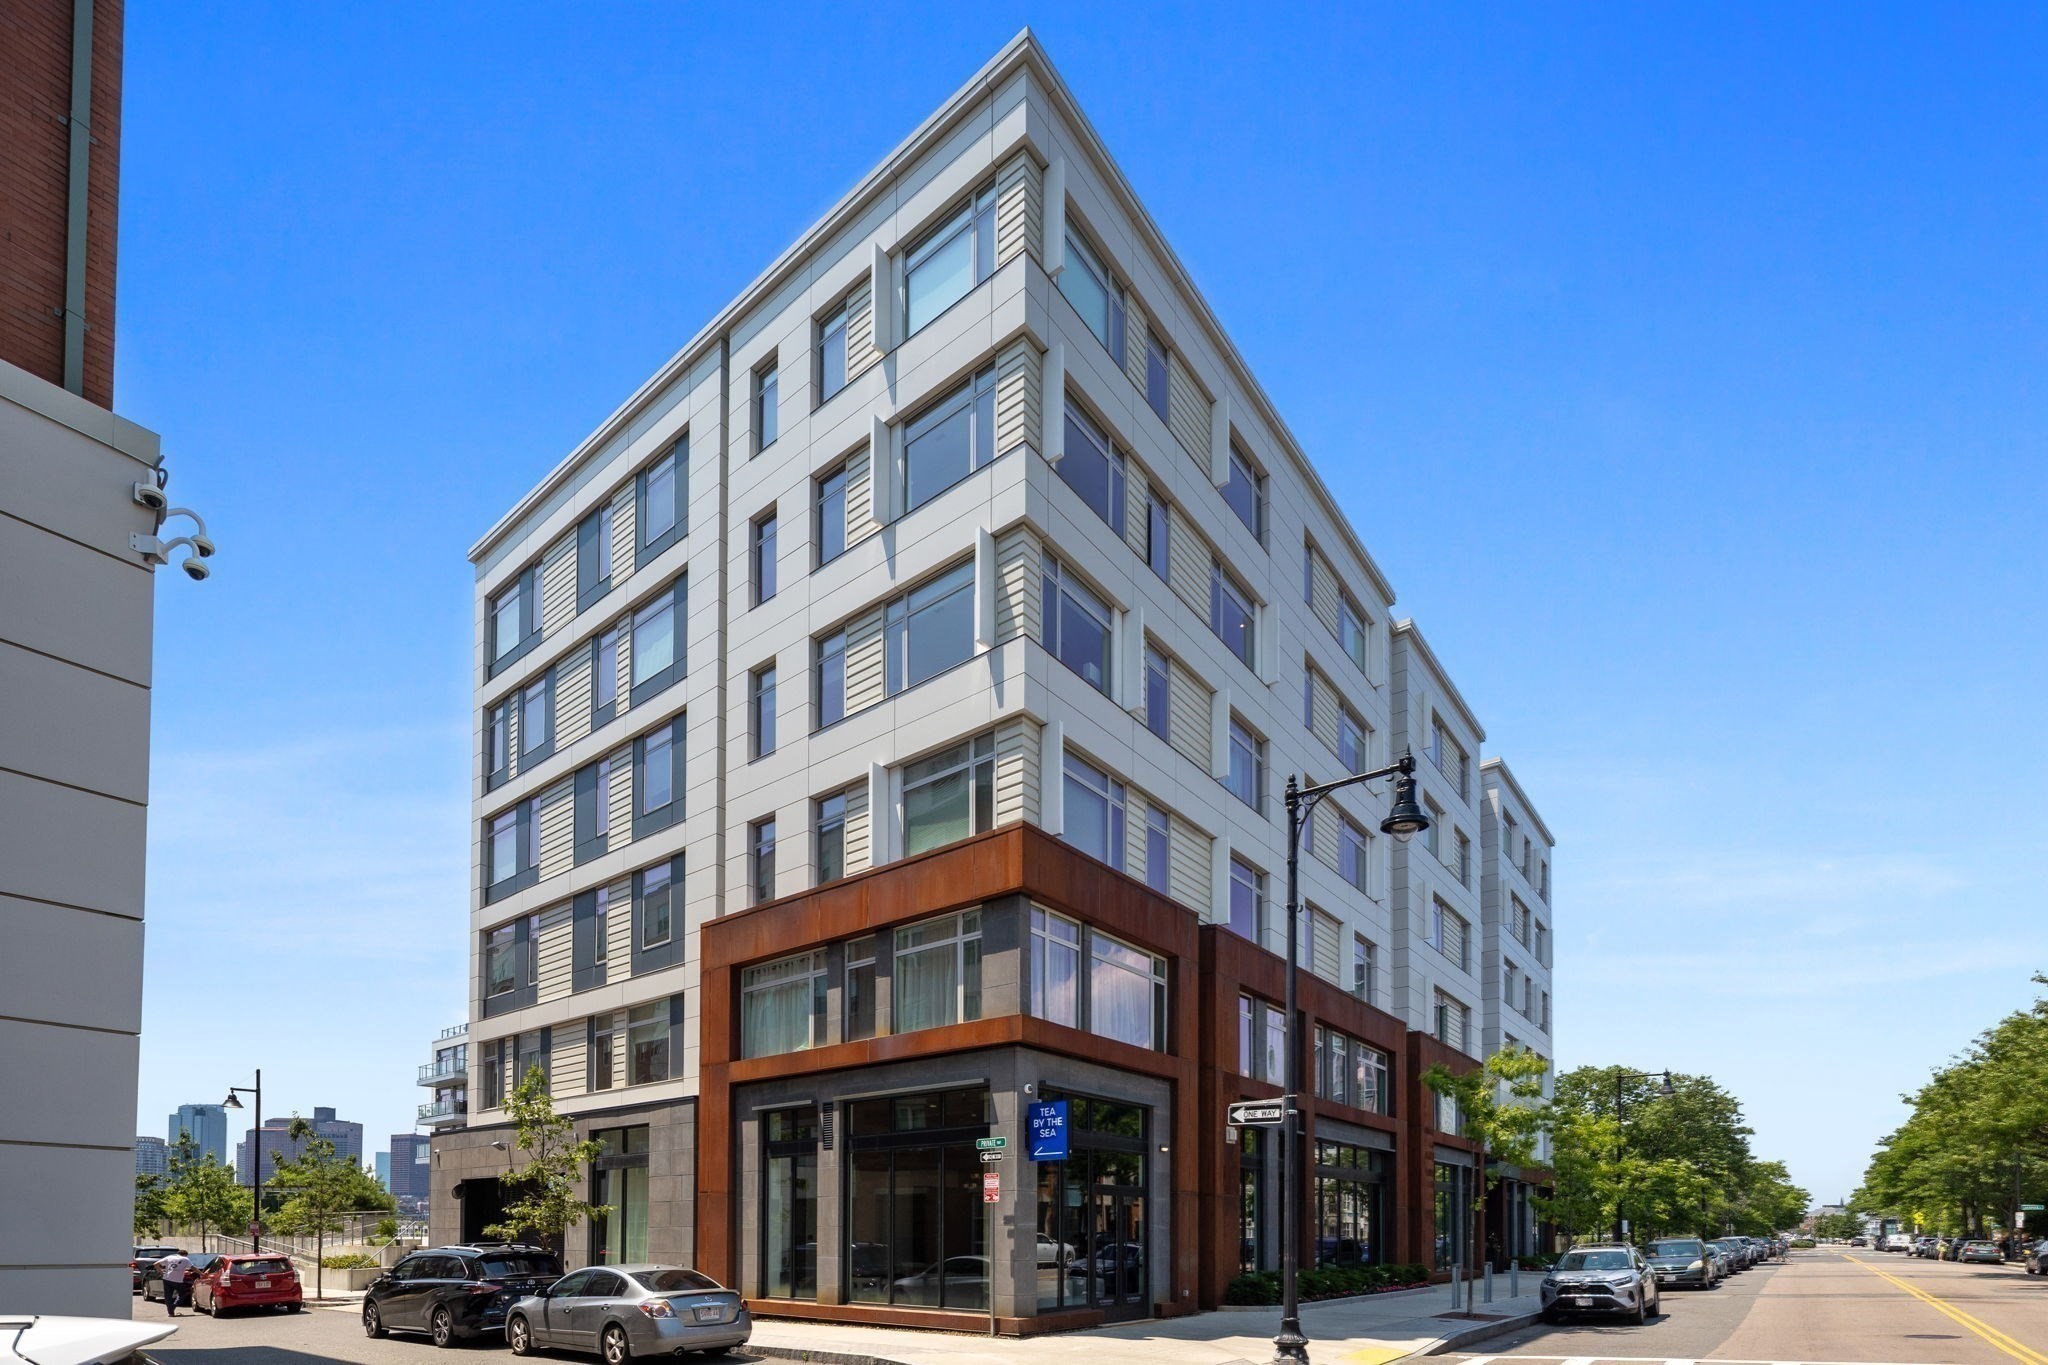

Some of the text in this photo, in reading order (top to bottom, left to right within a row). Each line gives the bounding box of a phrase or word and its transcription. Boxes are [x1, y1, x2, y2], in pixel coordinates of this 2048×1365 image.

[1040, 1108, 1056, 1116] TEA
[1033, 1117, 1063, 1128] BY THE
[1040, 1129, 1056, 1138] SEA
